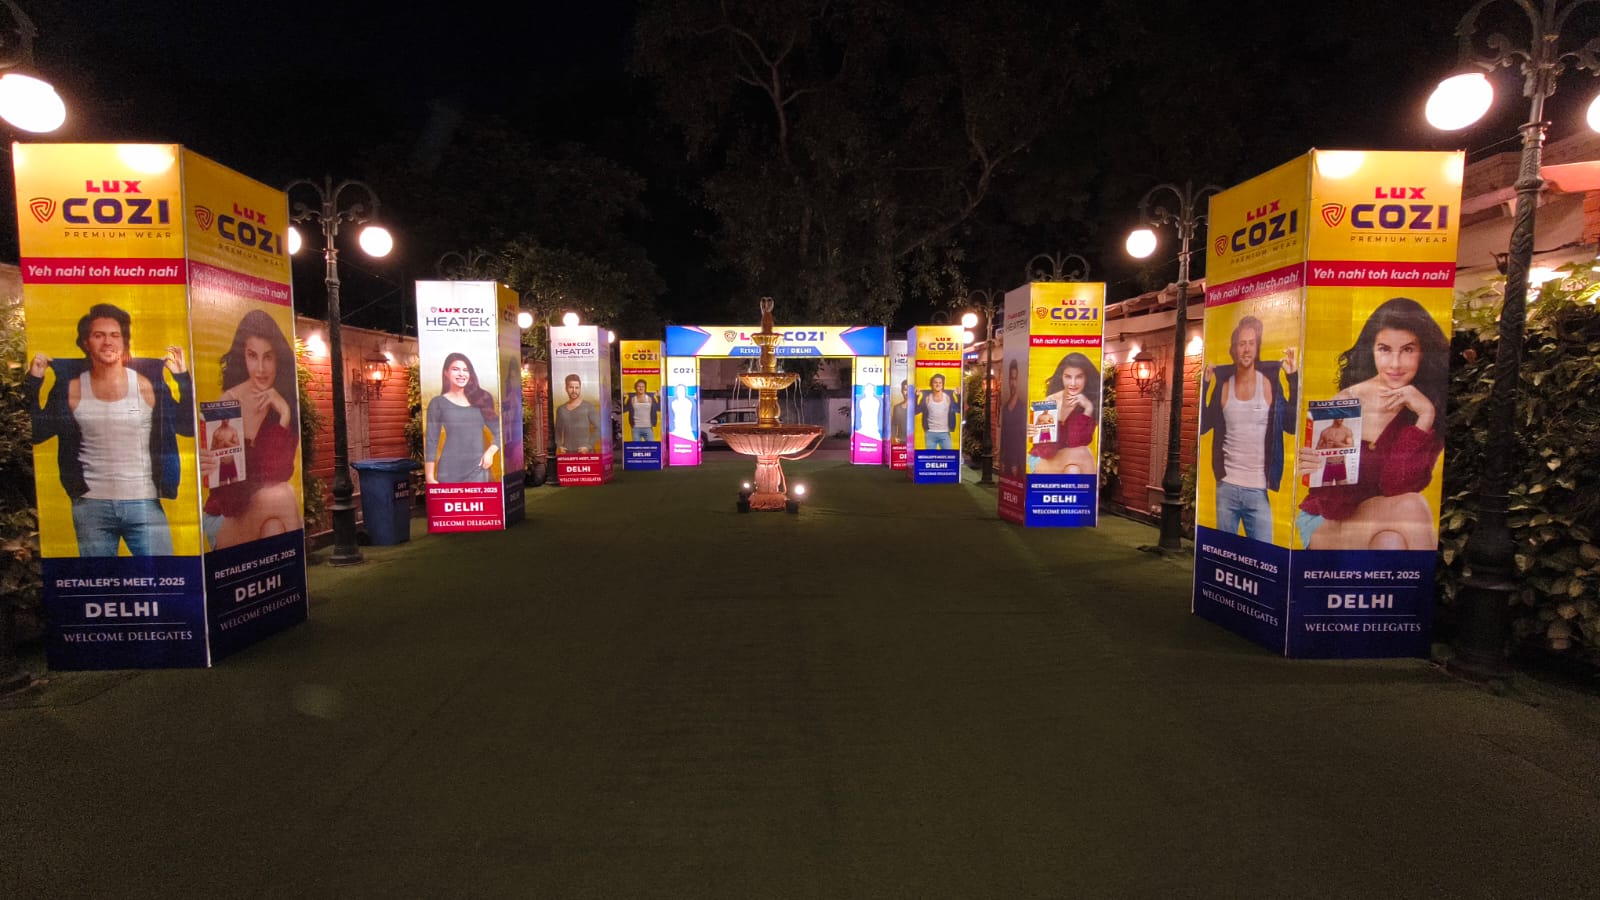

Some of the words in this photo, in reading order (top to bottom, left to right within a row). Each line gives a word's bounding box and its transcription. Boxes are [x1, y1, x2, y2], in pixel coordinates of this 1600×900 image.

[86, 180, 142, 193] LUX
[1375, 187, 1426, 199] LUX
[62, 198, 170, 224] COZI
[233, 202, 266, 225] LUX
[1246, 199, 1280, 222] LUX
[1351, 204, 1449, 230] COZI
[218, 214, 282, 256] COZI
[1232, 208, 1297, 252] COZI
[1231, 249, 1267, 264] PREMIUM
[1273, 240, 1296, 251] WEAR
[28, 265, 52, 278] Yeh
[55, 265, 85, 277] nahi
[89, 265, 110, 277] toh
[113, 265, 145, 277] kuch
[148, 265, 178, 277] nahi
[1314, 268, 1335, 279] Yeh
[1338, 268, 1366, 279] nahi
[1369, 269, 1388, 279] toh
[1391, 269, 1420, 279] kuch
[1422, 269, 1450, 280] nahi
[1209, 292, 1221, 301] Yeh
[1223, 285, 1240, 298] nahi
[1241, 282, 1255, 293] toh
[1277, 270, 1299, 284] nahi
[271, 289, 288, 300] nahi
[426, 317, 490, 326] HEATEK
[1050, 308, 1098, 320] COZI
[784, 332, 824, 341] COZI
[444, 502, 484, 512] DELHI
[1043, 495, 1077, 503] DELHI
[215, 560, 258, 580] RETAILER'S
[259, 554, 280, 570] MEET,
[281, 549, 296, 560] 2025
[1202, 544, 1237, 561] RETAILER'S
[1238, 555, 1259, 569] MEET,
[1260, 561, 1278, 574] 2025
[56, 578, 121, 588] RETAILER'S
[123, 577, 157, 588] MEET,
[159, 577, 185, 586] 2025
[1215, 568, 1258, 595] DELHI
[1304, 571, 1362, 580] RETAILER'S
[1364, 571, 1394, 581] MEET,
[1396, 571, 1421, 580] 2025
[235, 574, 282, 602] DELHI
[85, 601, 159, 618] DELHI
[1202, 588, 1235, 610] WELCOME
[1236, 602, 1279, 626] DELEGATES
[1327, 594, 1393, 609] DELHI
[219, 608, 261, 632] WELCOME
[262, 592, 301, 616] DELEGATES
[1305, 623, 1360, 632] WELCOME
[1362, 623, 1421, 632] DELEGATES
[64, 631, 124, 642] WELCOME
[128, 630, 193, 641] DELEGATES
